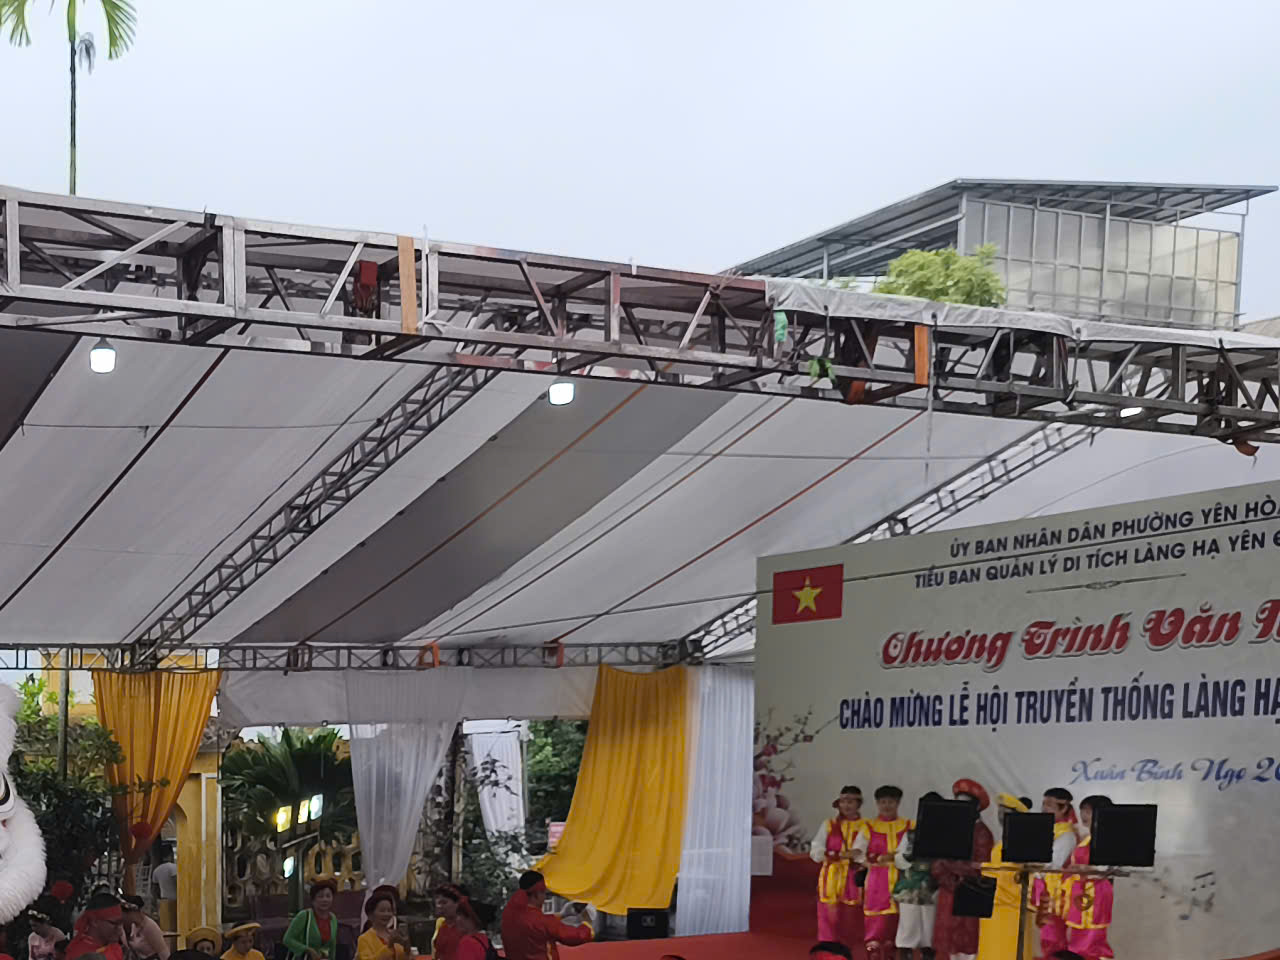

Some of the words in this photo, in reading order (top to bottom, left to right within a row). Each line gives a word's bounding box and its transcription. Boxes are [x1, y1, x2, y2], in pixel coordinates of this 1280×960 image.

[950, 537, 969, 558] ỦY
[975, 536, 1008, 555] BAN
[1013, 527, 1061, 550] NHÂN
[1067, 521, 1105, 543] DÂN
[1111, 511, 1193, 537] PHƯỜNG
[1201, 502, 1237, 525] YÊN
[1245, 494, 1280, 519] HÒ
[914, 564, 944, 588] TIỂU
[948, 567, 981, 586] BAN
[985, 558, 1034, 581] QUẢN
[1039, 553, 1058, 575] LÝ
[1063, 554, 1080, 573] DI
[1086, 548, 1128, 569] TÍCH
[1134, 542, 1185, 564] LÀNG
[1192, 538, 1220, 559] HẠ
[1228, 529, 1266, 552] YÊN
[881, 629, 1016, 672] Chương
[1021, 611, 1132, 658] Trình
[1140, 602, 1243, 650] Văn
[839, 691, 884, 729] CHÀO
[889, 688, 943, 728] MỪNG
[949, 681, 970, 726] LỄ
[976, 685, 1008, 732] HỘI
[1101, 671, 1174, 721] THỐNG
[1182, 673, 1246, 719] LÀNG
